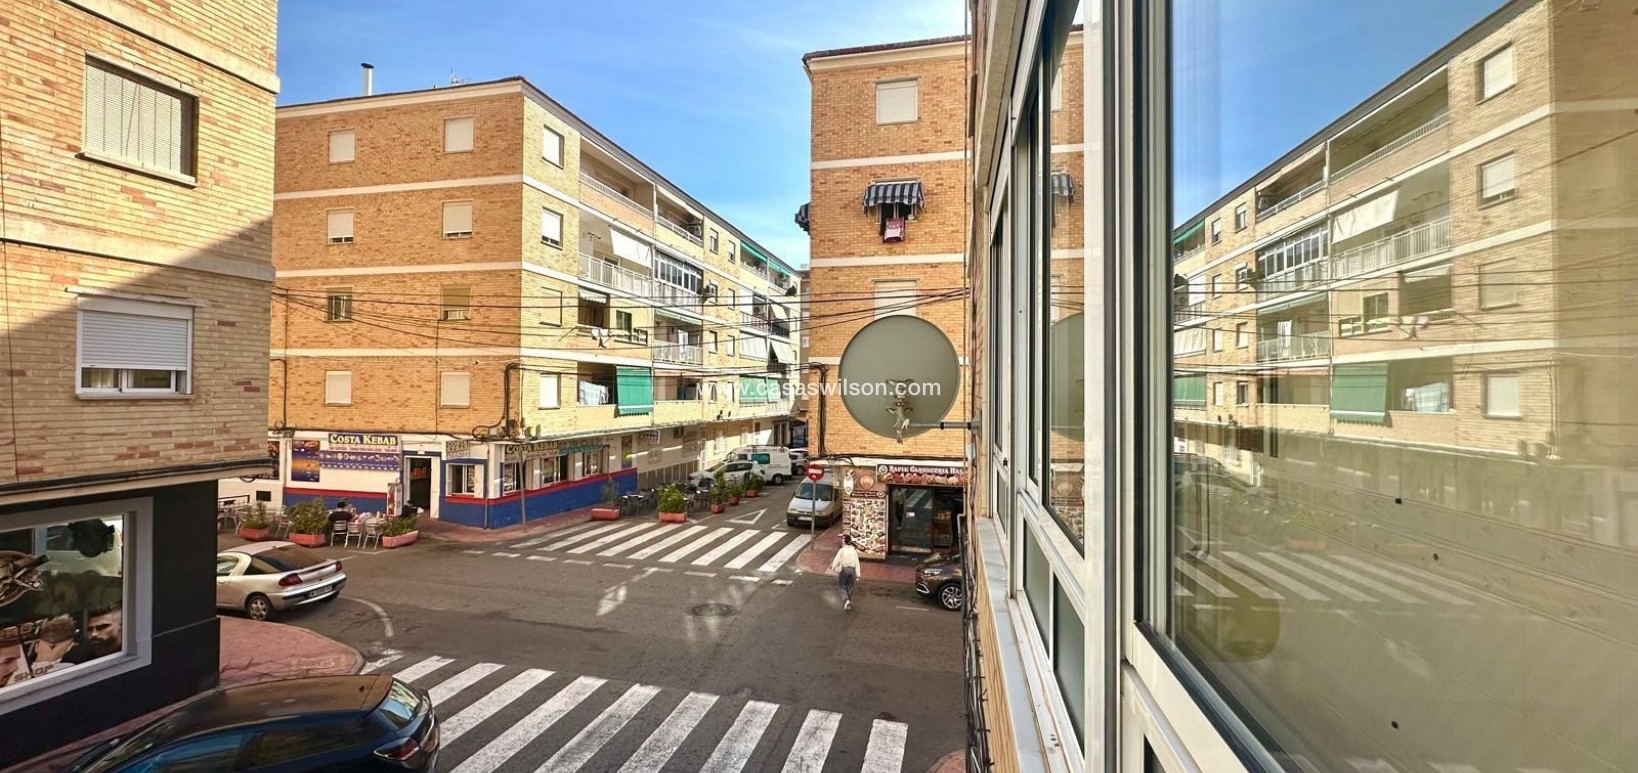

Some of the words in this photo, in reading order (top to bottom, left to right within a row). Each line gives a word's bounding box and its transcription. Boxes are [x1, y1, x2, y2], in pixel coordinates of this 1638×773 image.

[330, 434, 360, 444] COSTA
[363, 434, 396, 445] KEBAB
[14, 664, 54, 682] SHOP
